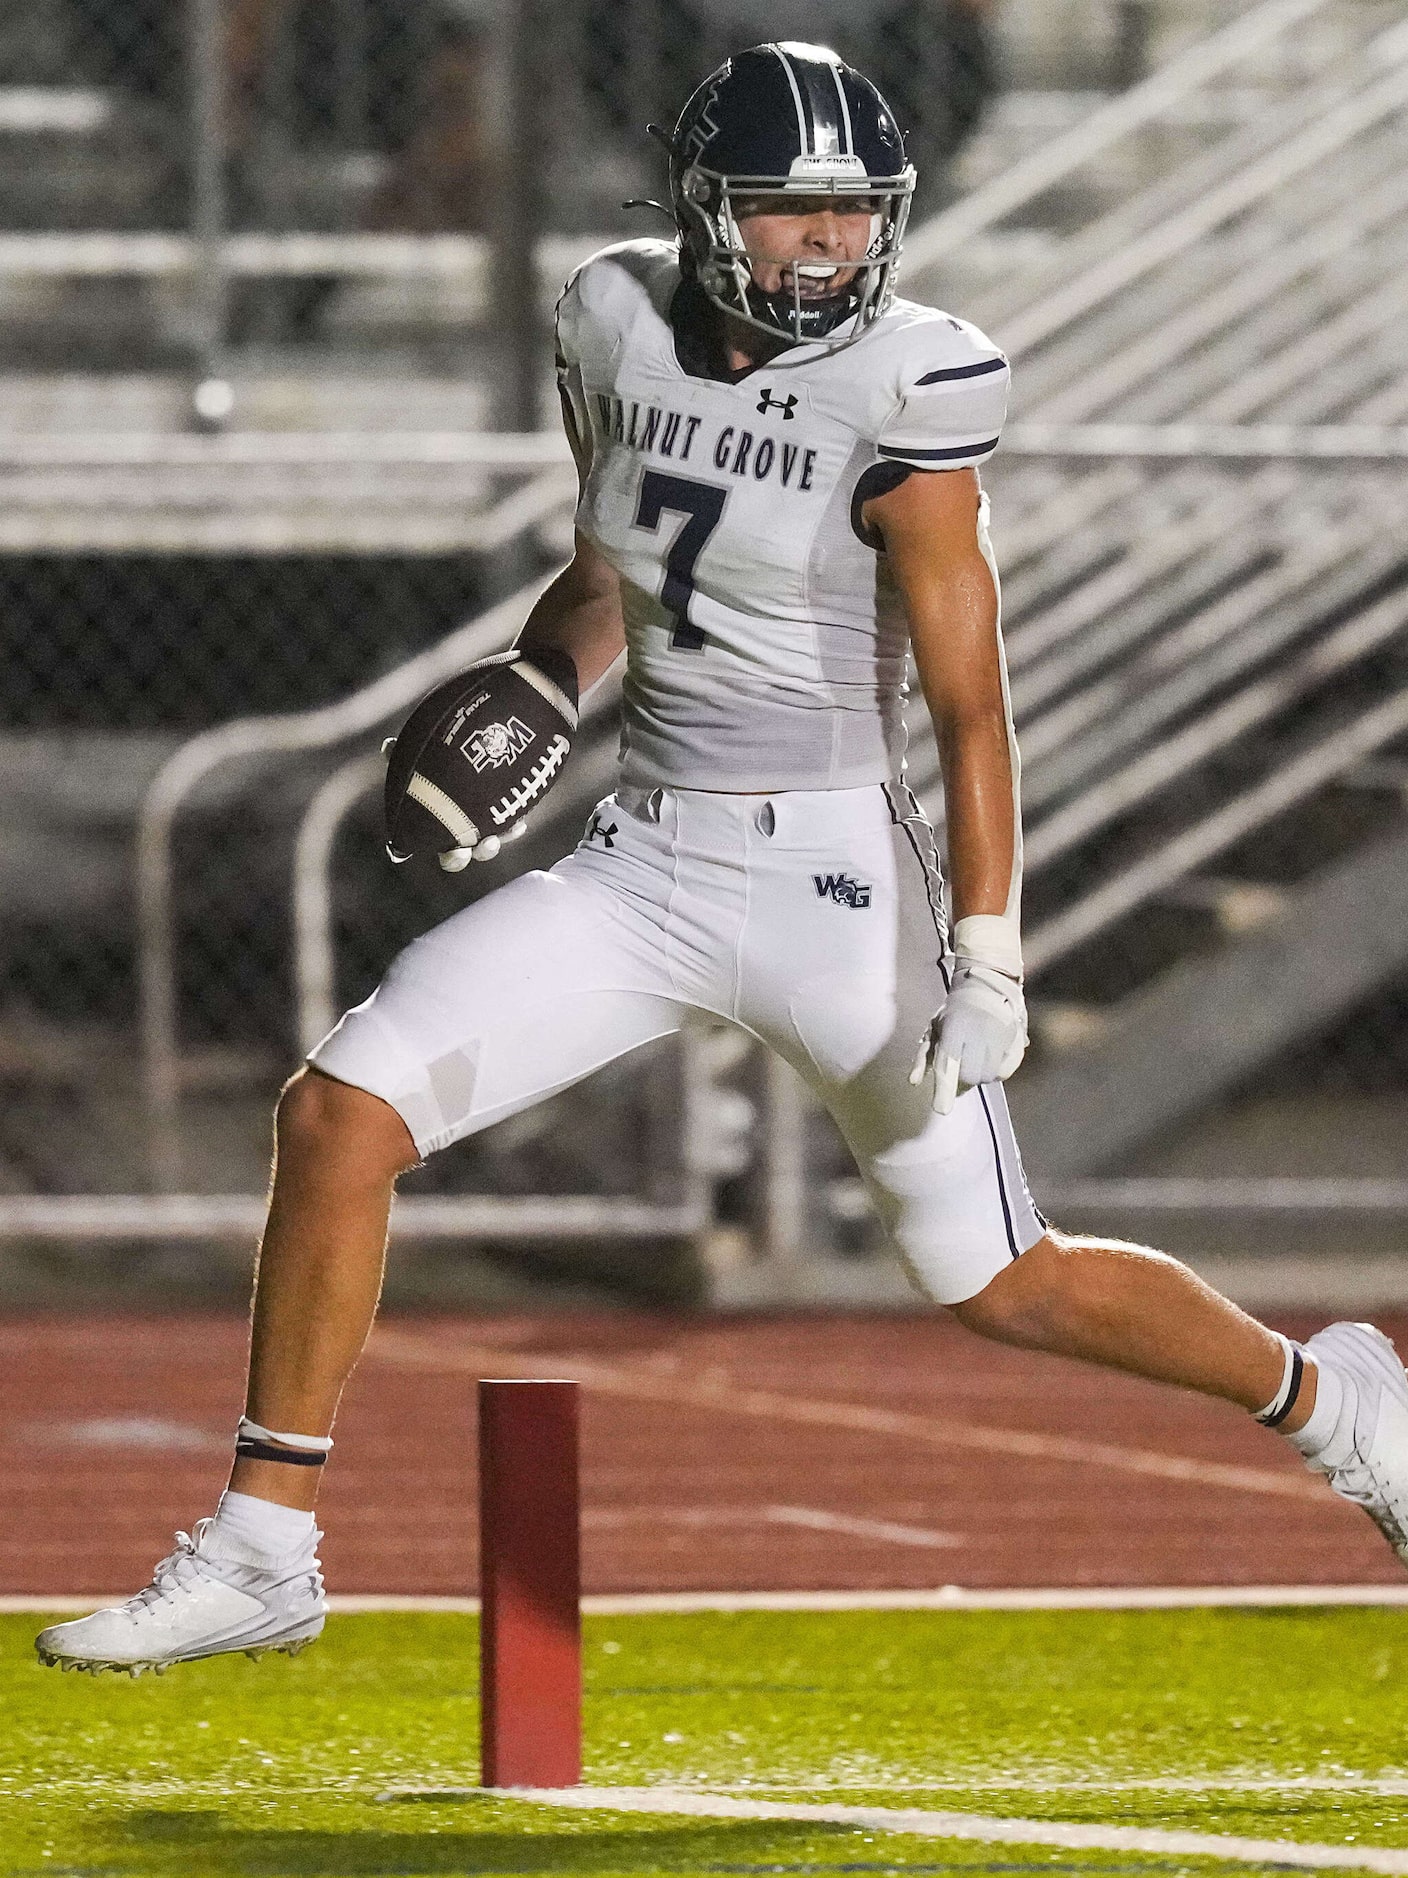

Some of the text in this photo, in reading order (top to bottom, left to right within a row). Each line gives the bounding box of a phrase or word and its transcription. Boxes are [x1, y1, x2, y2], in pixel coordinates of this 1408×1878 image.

[597, 393, 818, 494] WALNUT GROVE
[630, 464, 735, 656] 7
